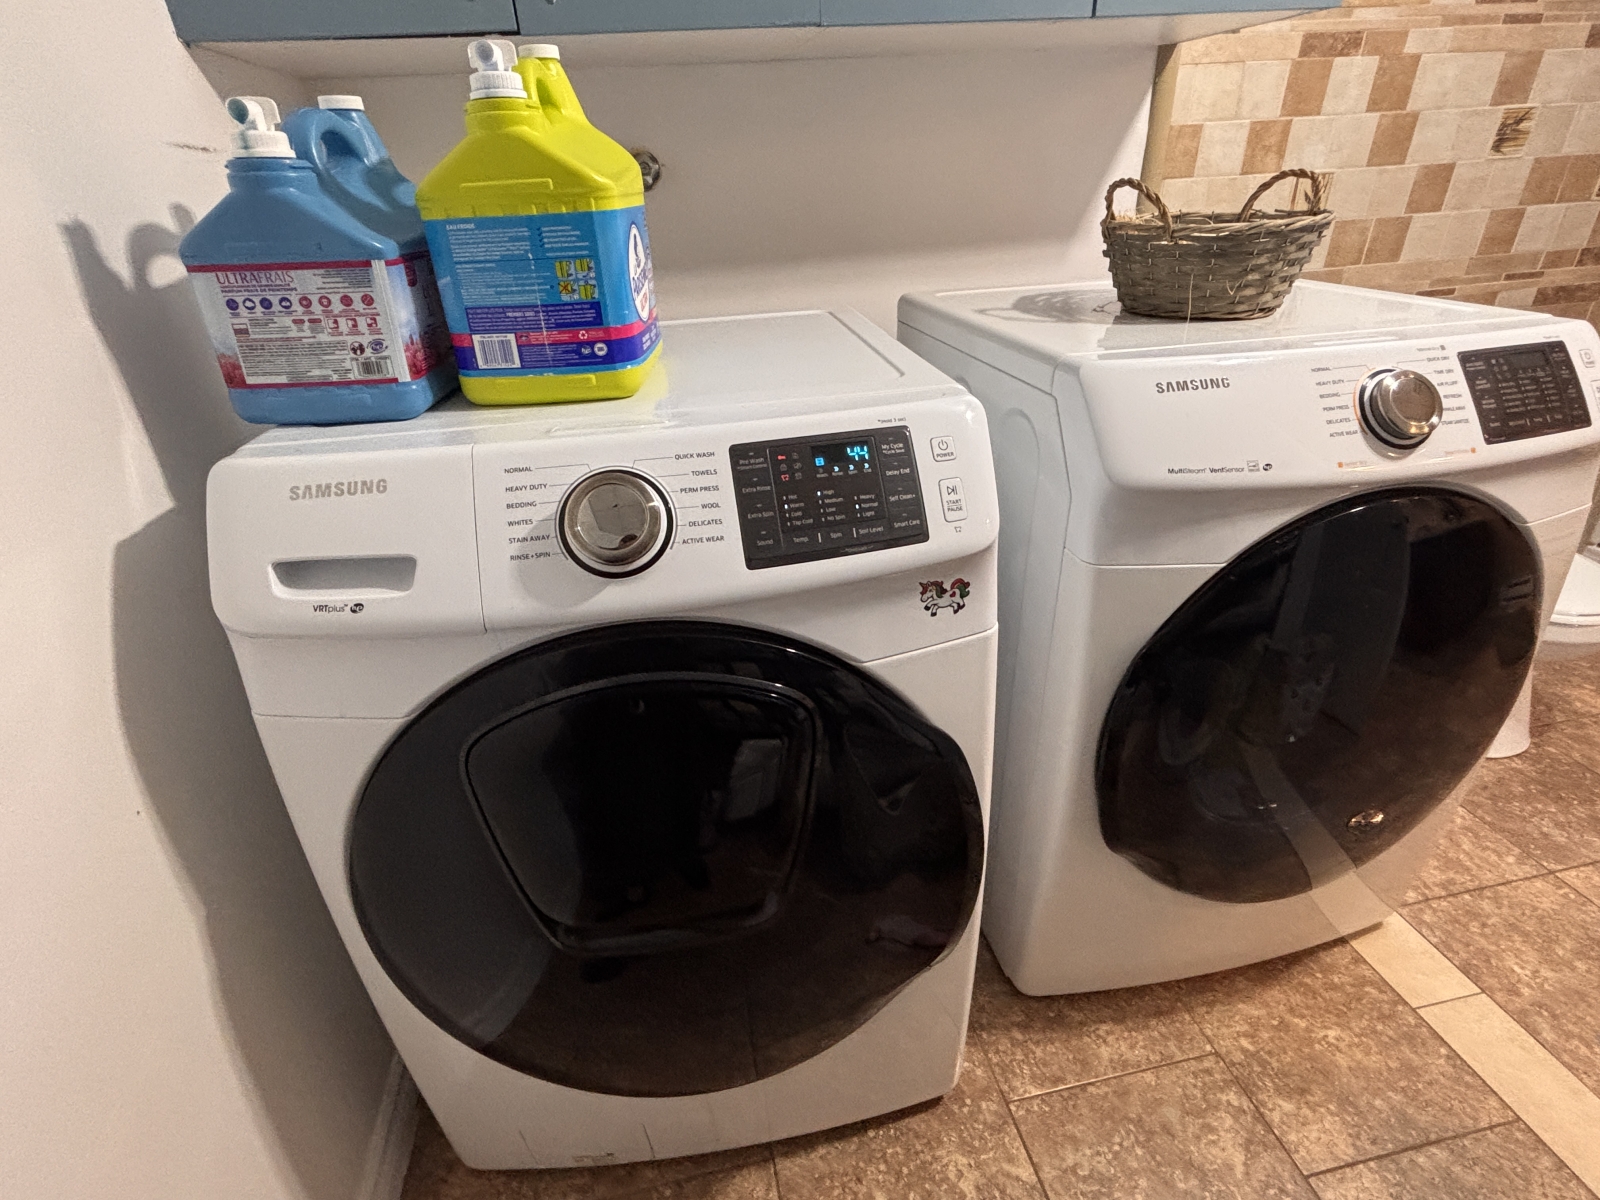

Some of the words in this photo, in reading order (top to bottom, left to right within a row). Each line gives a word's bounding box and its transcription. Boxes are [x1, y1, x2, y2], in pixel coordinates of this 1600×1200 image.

[215, 271, 294, 284] ULTRAFRAIS
[1156, 377, 1230, 394] SAMSUNG
[674, 452, 696, 460] QUICK
[697, 451, 715, 459] WASH
[846, 445, 869, 461] 44
[504, 466, 533, 474] NORMAL
[691, 469, 718, 477] TOWELS
[1209, 466, 1245, 474] VentSensor
[289, 478, 388, 500] SAMSUNG
[505, 484, 528, 493] HEAVY
[680, 486, 700, 494] PERM
[701, 485, 720, 493] PRESS
[506, 501, 537, 510] BEDDING
[508, 518, 533, 527] WHITES
[688, 518, 723, 527] DELICATES
[894, 520, 909, 528] Smart
[508, 536, 528, 544] STAIN
[529, 534, 550, 542] AWAY
[682, 536, 704, 544] ACTIVE
[705, 535, 724, 543] WEAR
[510, 552, 551, 561] RINSE+SPIN
